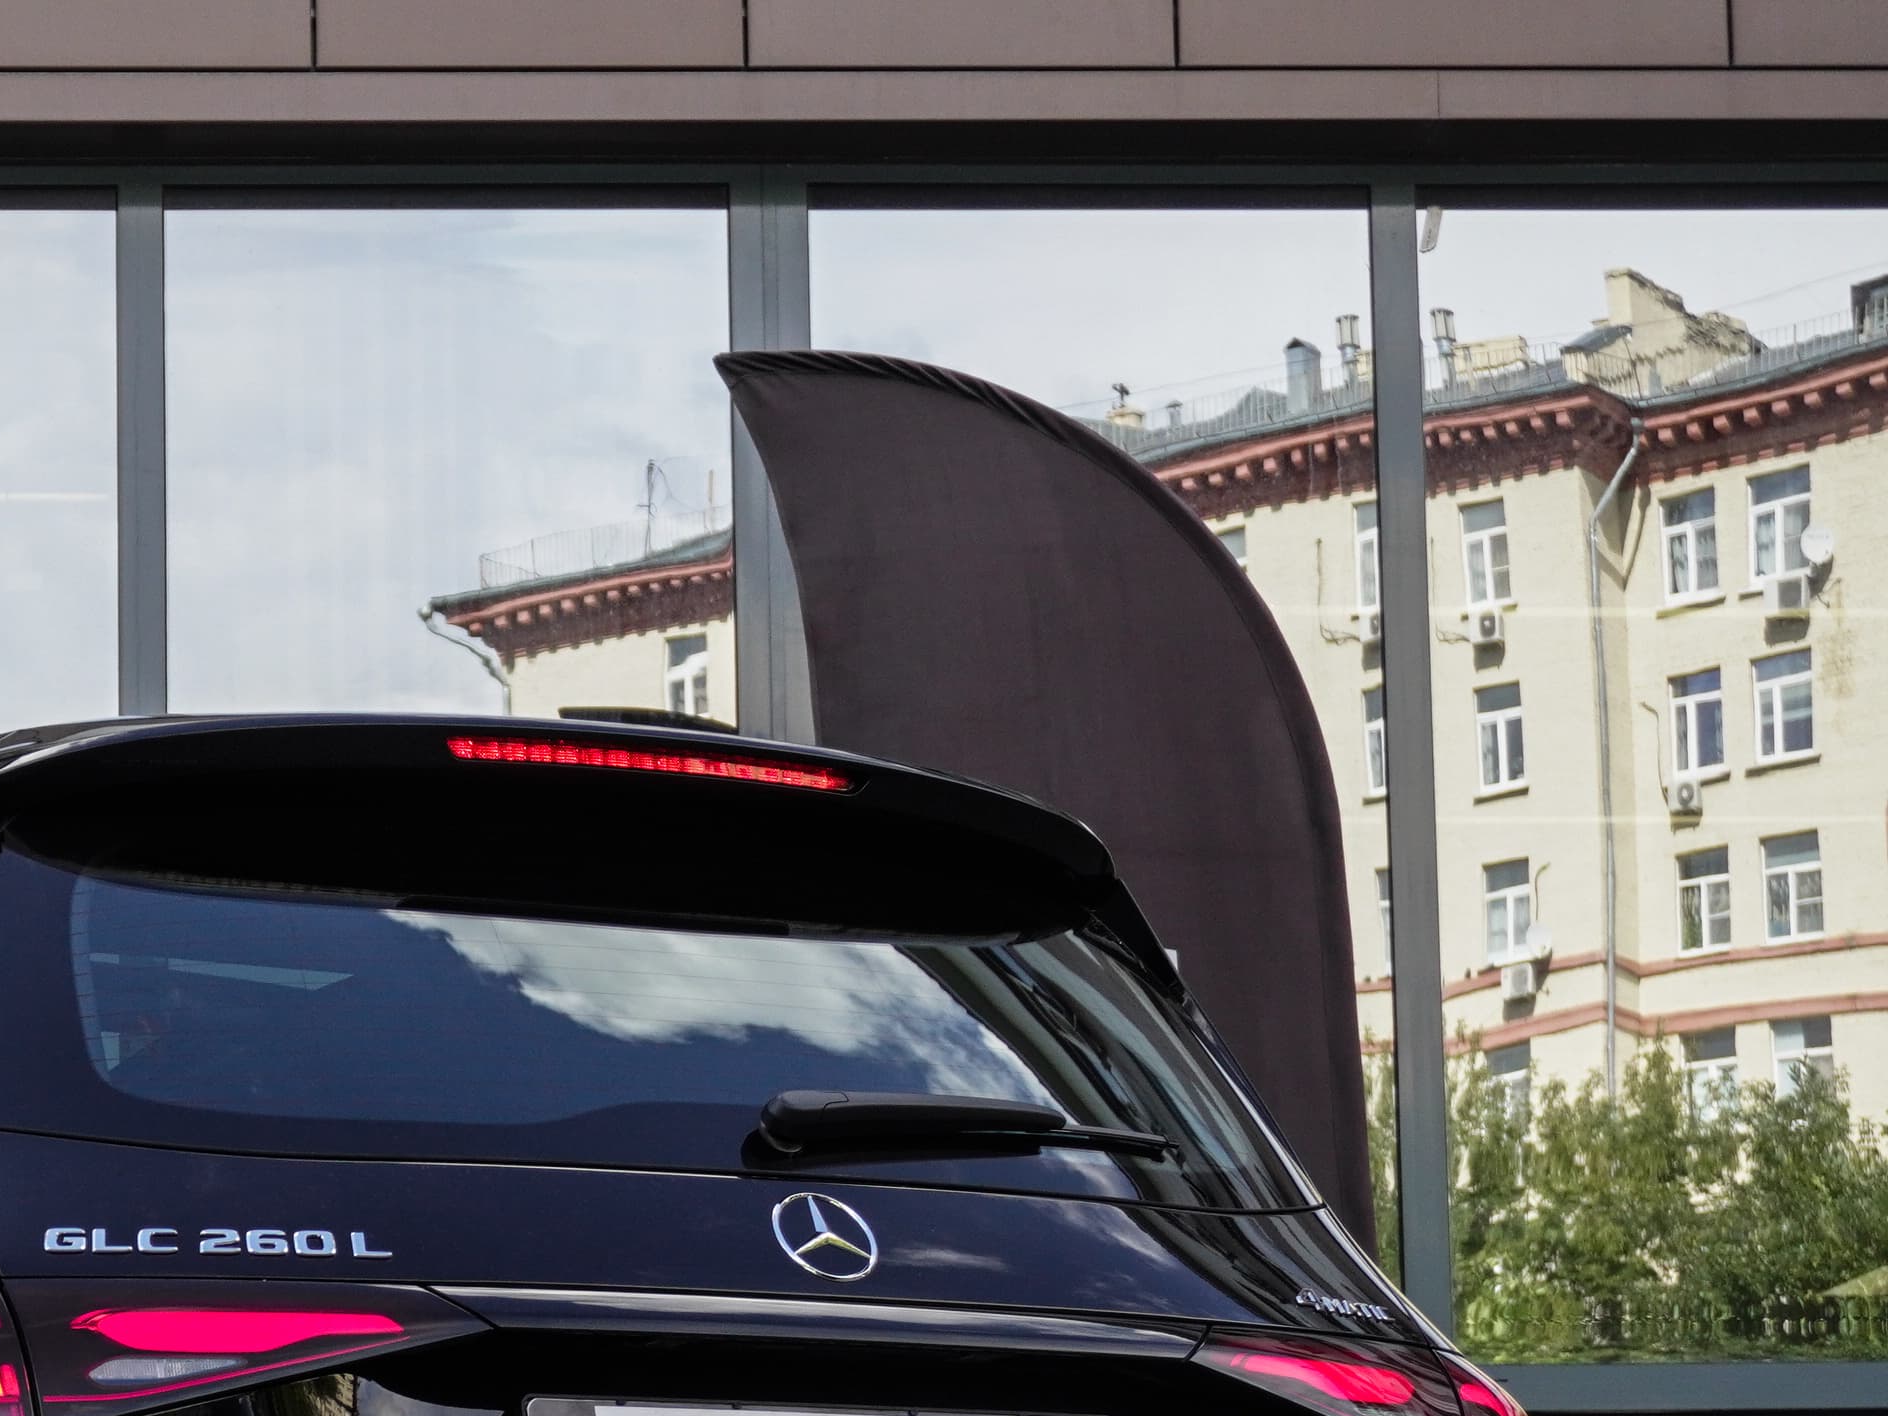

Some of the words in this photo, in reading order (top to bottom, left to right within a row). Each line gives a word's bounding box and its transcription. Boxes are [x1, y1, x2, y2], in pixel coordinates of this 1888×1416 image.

[44, 1227, 178, 1253] GLC
[199, 1228, 337, 1256] 260
[350, 1231, 393, 1258] L
